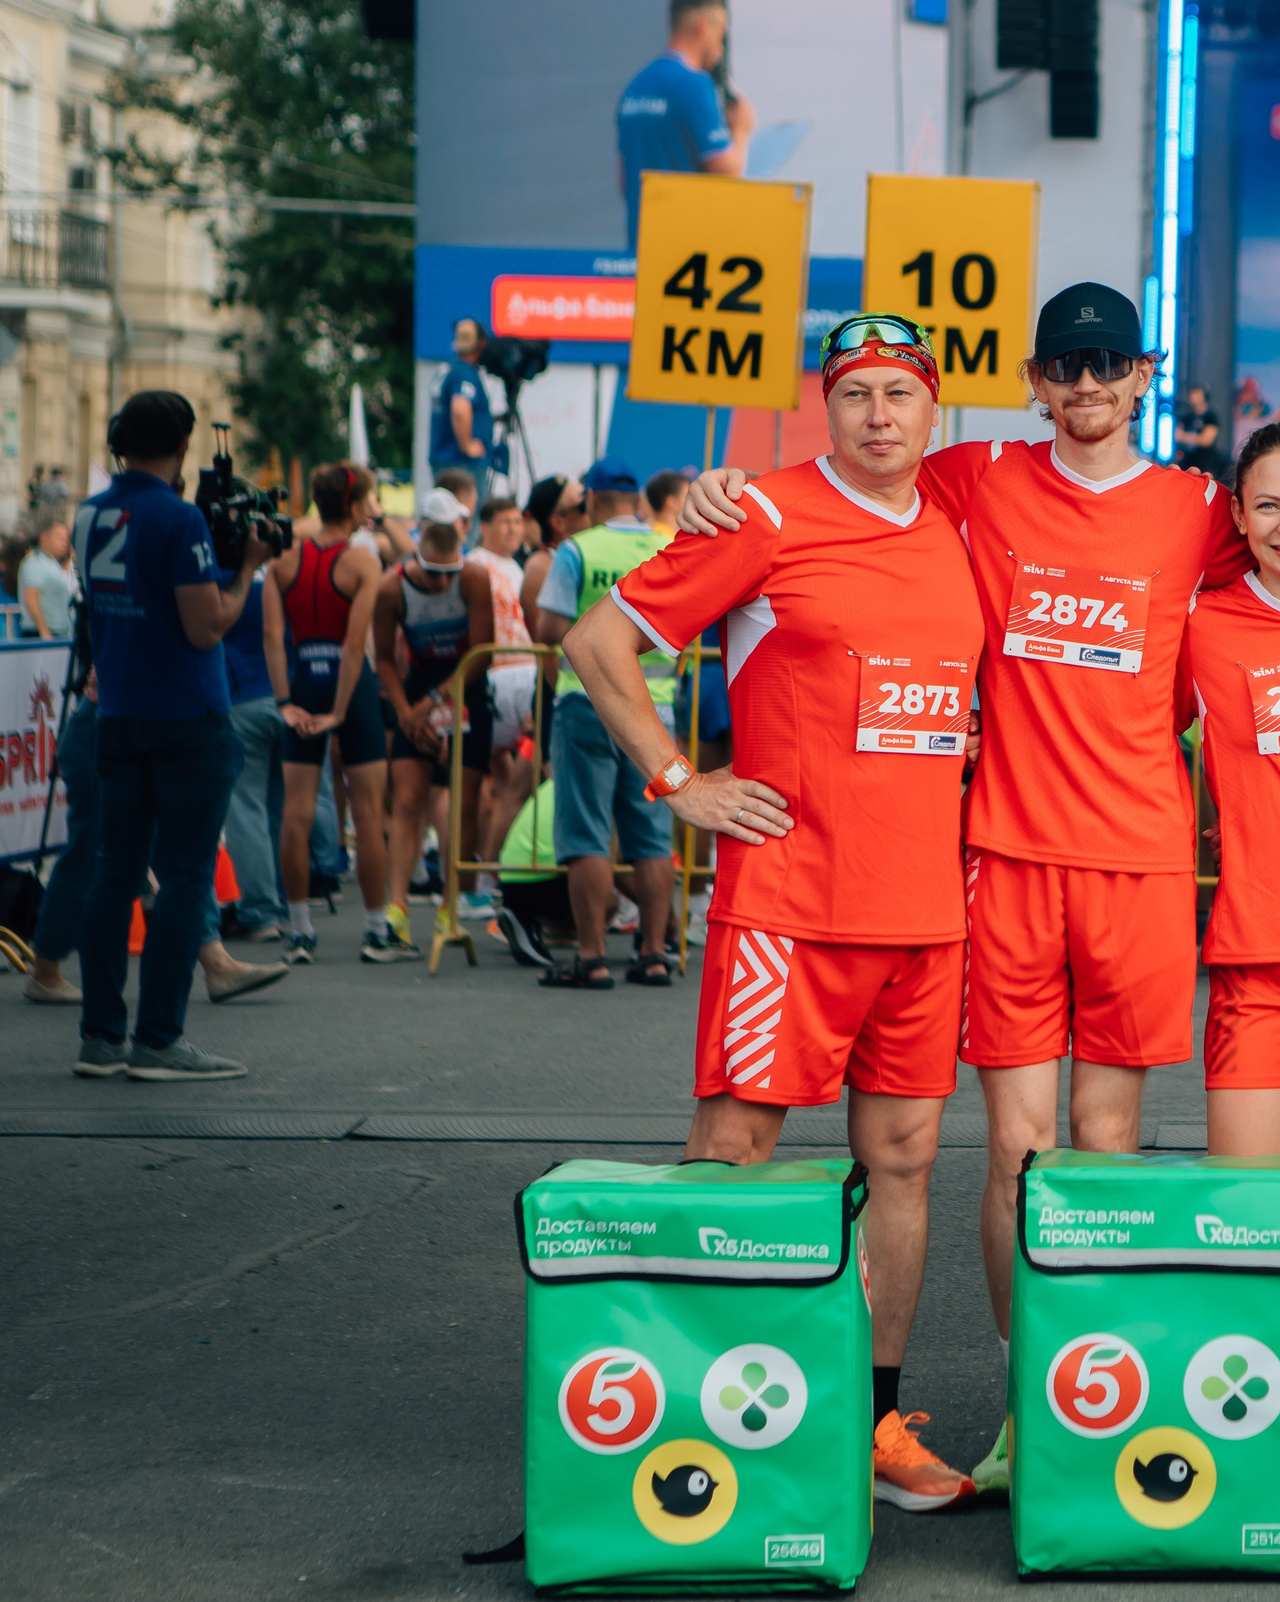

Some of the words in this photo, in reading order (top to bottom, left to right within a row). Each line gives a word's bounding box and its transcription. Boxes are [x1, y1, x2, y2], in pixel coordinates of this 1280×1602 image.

[663, 253, 764, 314] 42
[901, 250, 997, 311] 10
[661, 326, 763, 380] КМ
[927, 327, 998, 375] М
[1104, 576, 1131, 585] АВГУСТА
[1027, 591, 1128, 633] 2874
[1028, 643, 1047, 652] Альфа
[1047, 646, 1061, 654] Банк
[878, 682, 960, 717] 2873
[535, 1217, 656, 1236] Доставляем
[1039, 1206, 1154, 1226] Доставляем
[536, 1238, 631, 1257] продукты
[1040, 1228, 1130, 1247] продукты
[587, 1358, 640, 1433] 5
[1073, 1345, 1126, 1419] 5
